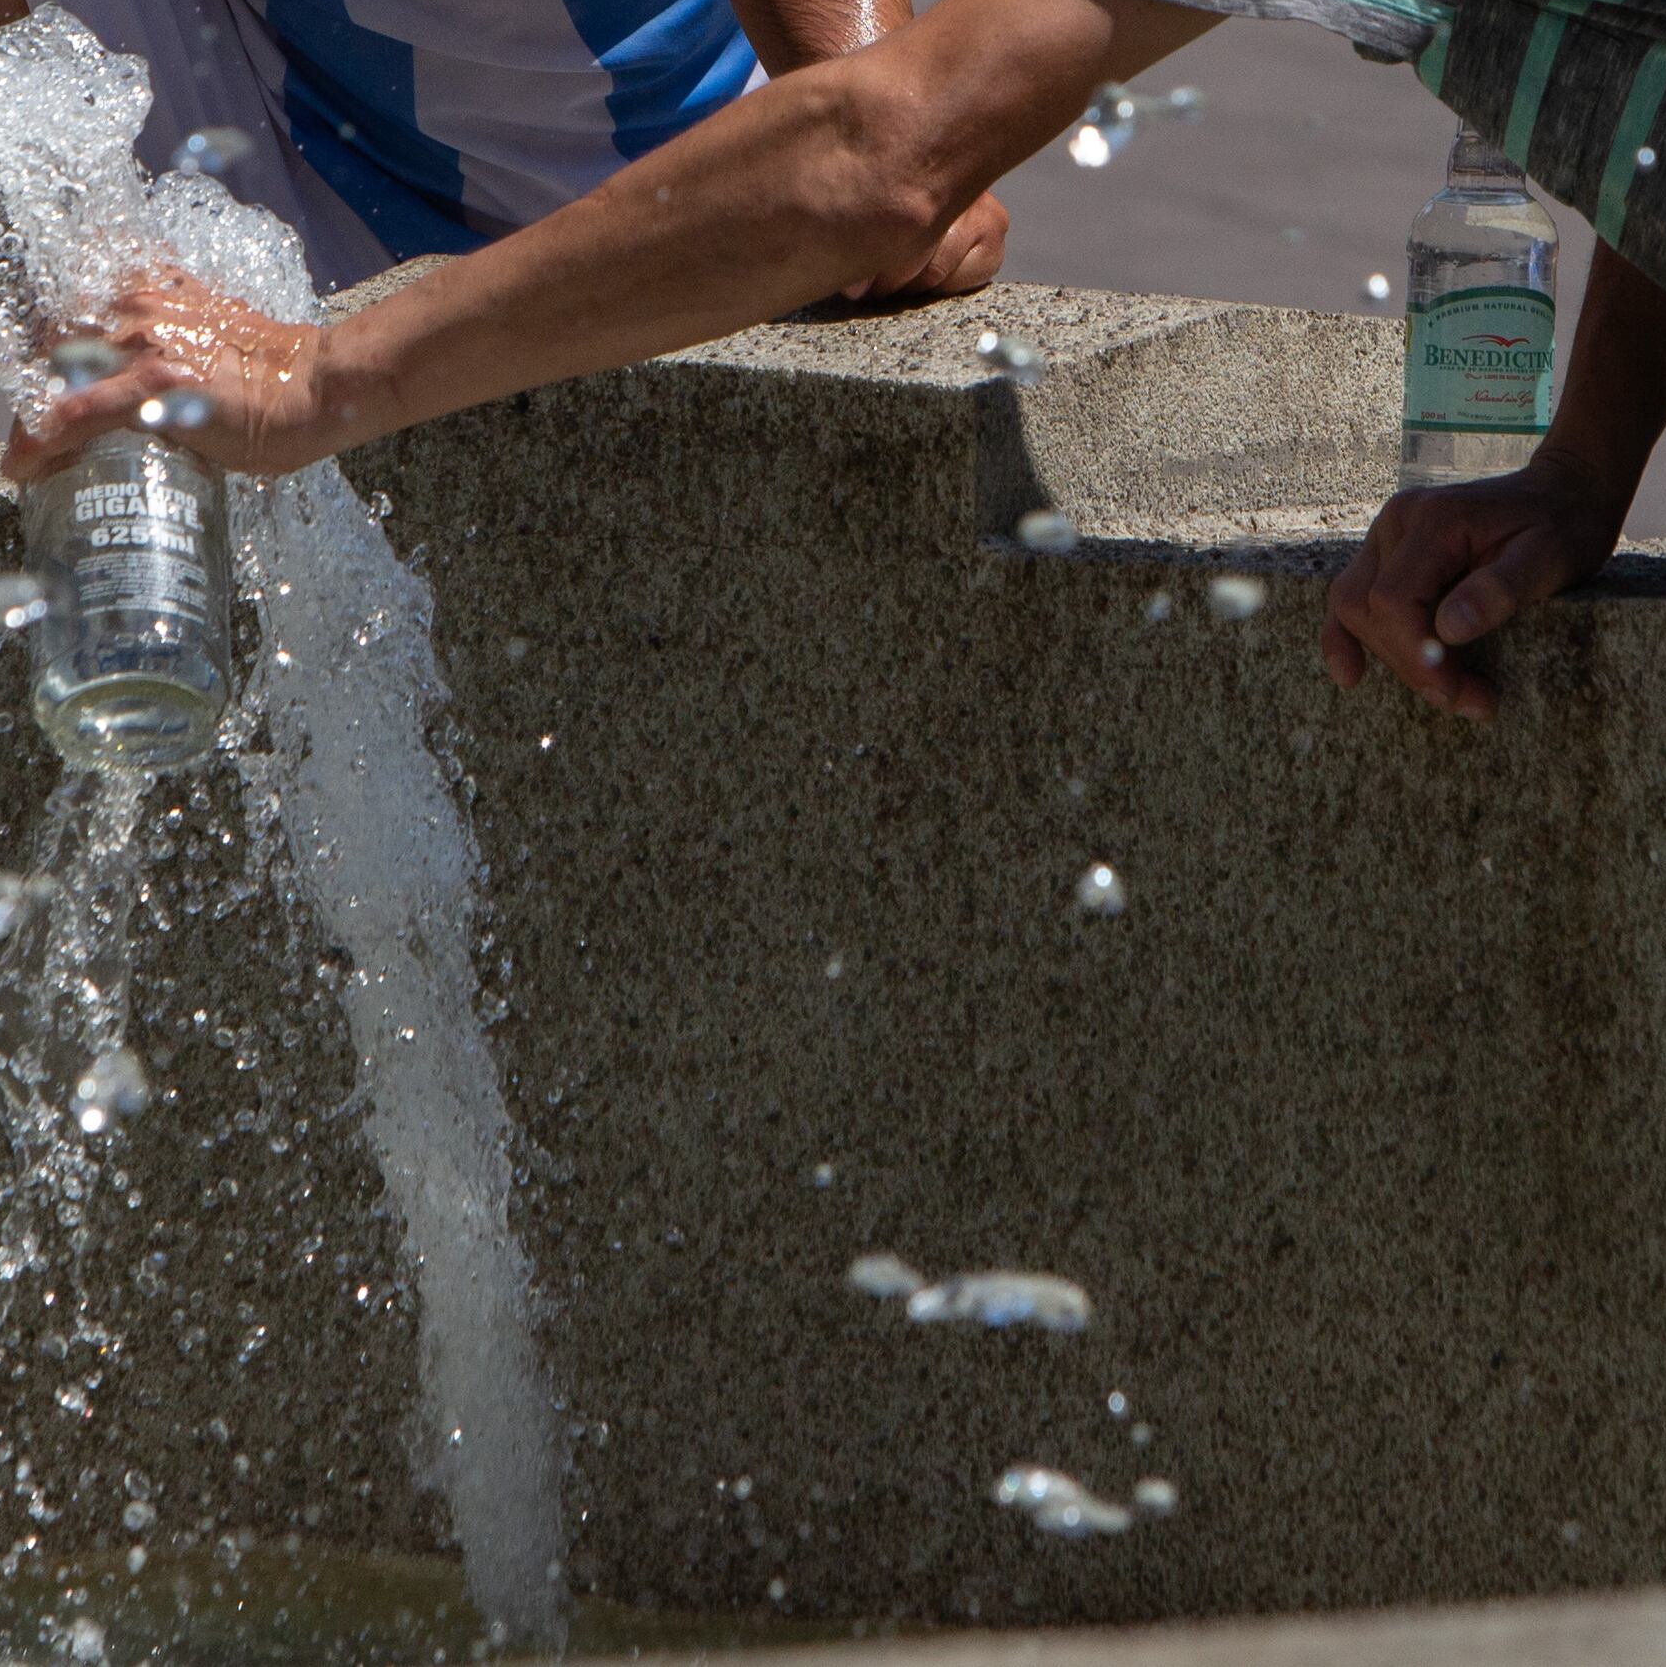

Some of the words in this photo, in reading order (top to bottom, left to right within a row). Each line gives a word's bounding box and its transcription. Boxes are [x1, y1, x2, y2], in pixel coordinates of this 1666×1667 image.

[1435, 303, 1480, 321] PREMIUM
[1484, 301, 1527, 312] NATURAL
[1420, 411, 1436, 421] 500
[1436, 412, 1447, 421] ml
[74, 482, 140, 504] MEDIO
[145, 484, 198, 510] LITRO
[91, 525, 151, 549] 625
[160, 530, 196, 556] ml
